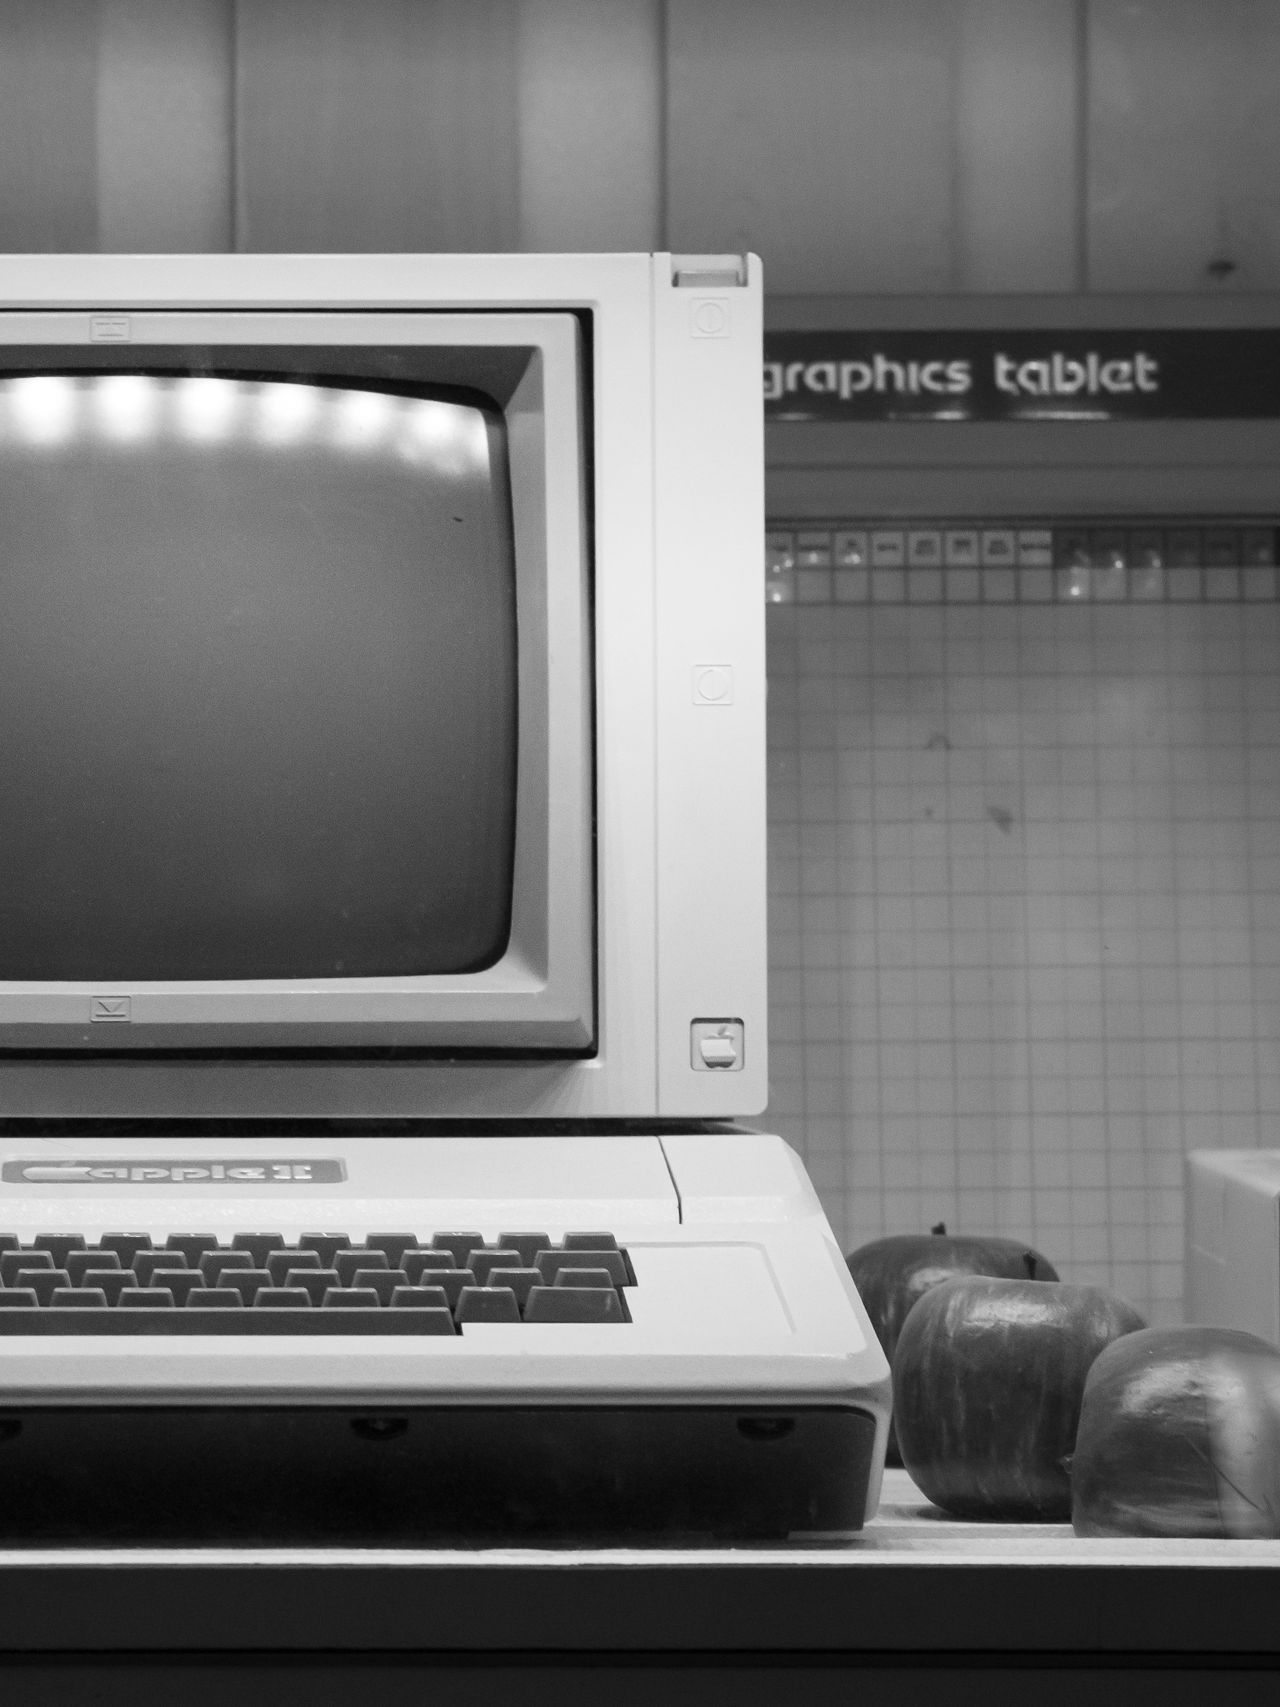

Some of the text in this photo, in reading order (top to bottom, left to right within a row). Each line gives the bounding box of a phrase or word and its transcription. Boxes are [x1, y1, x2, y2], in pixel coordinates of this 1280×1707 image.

[764, 352, 1159, 400] graphics tablet
[88, 1164, 266, 1181] apple
